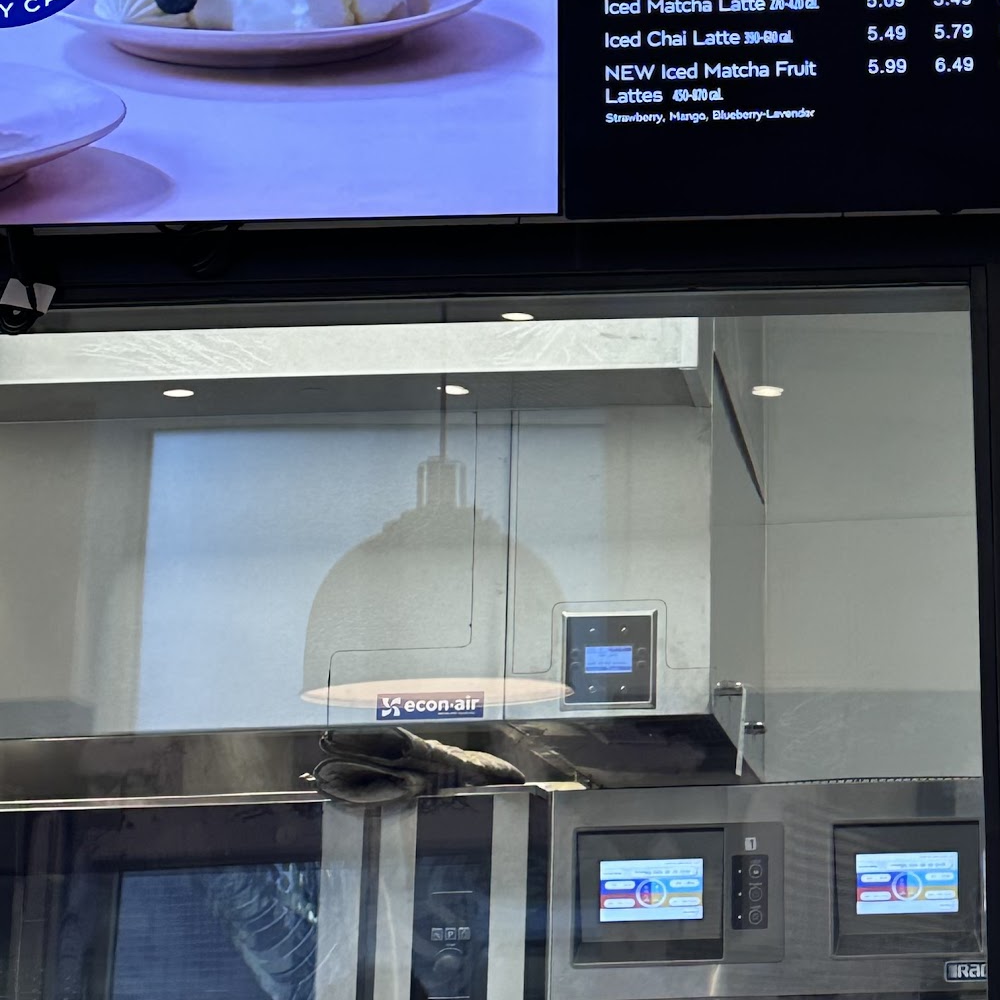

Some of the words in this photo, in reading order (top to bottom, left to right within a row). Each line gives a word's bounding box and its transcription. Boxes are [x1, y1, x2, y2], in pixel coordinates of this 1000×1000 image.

[604, 30, 642, 48] Iced
[646, 30, 687, 48] Chai
[693, 30, 742, 46] Latte
[605, 64, 656, 82] NEW
[661, 62, 698, 80] Iced
[704, 60, 770, 79] Matcha
[776, 60, 817, 77] Fruit
[605, 88, 664, 104] Lattes
